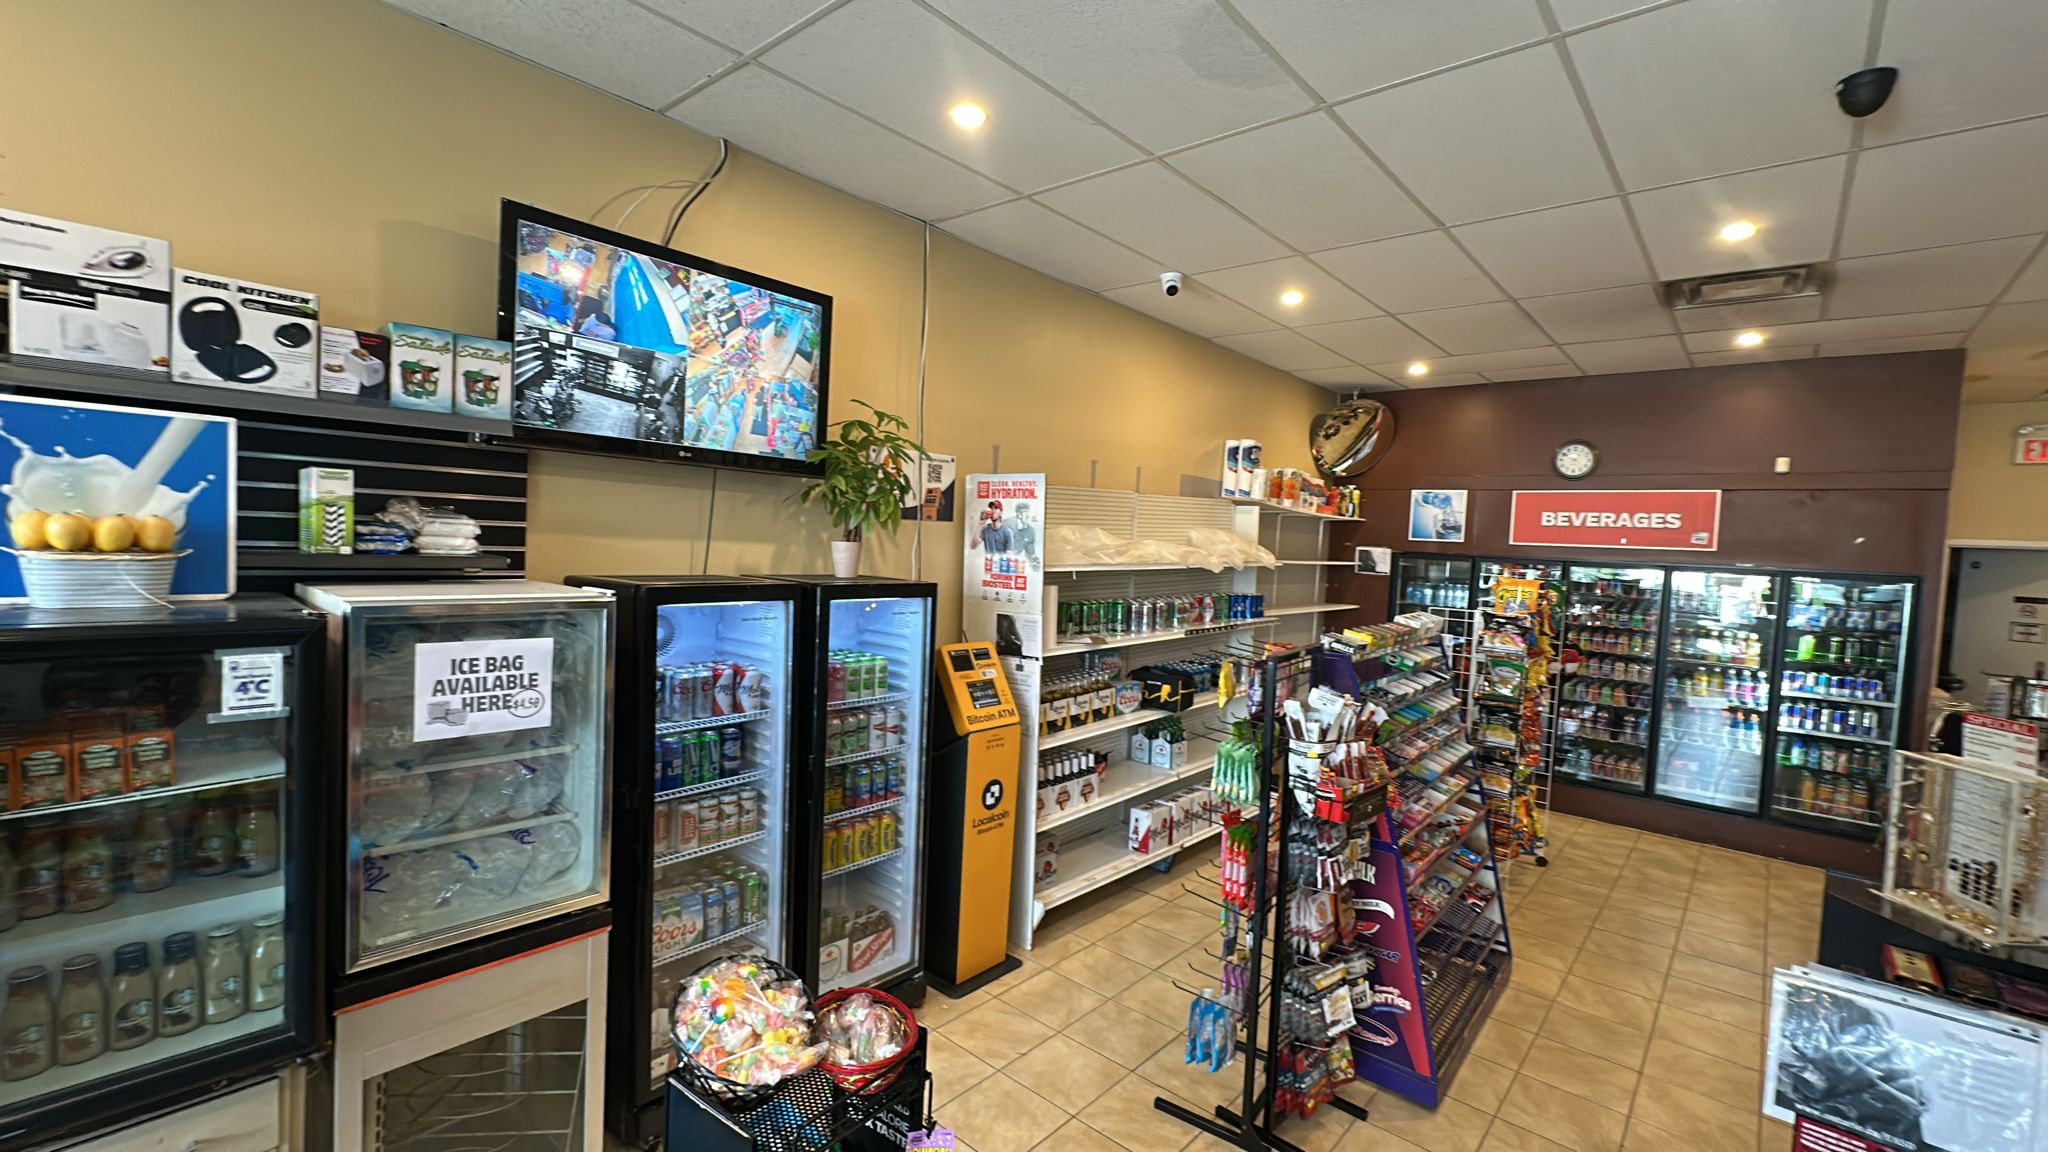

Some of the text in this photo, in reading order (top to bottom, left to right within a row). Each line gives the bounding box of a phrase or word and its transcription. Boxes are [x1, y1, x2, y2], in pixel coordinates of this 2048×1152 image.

[182, 275, 312, 305] COOL KITCHEN
[1541, 511, 1682, 529] BEVERAGES
[451, 654, 525, 676] ICE BAG
[432, 673, 539, 697] AVAILABLE
[461, 693, 513, 714] HERE
[966, 707, 1017, 725] Bitcoin ATM
[972, 808, 1010, 828] Localcoin
[1368, 991, 1412, 1011] erries
